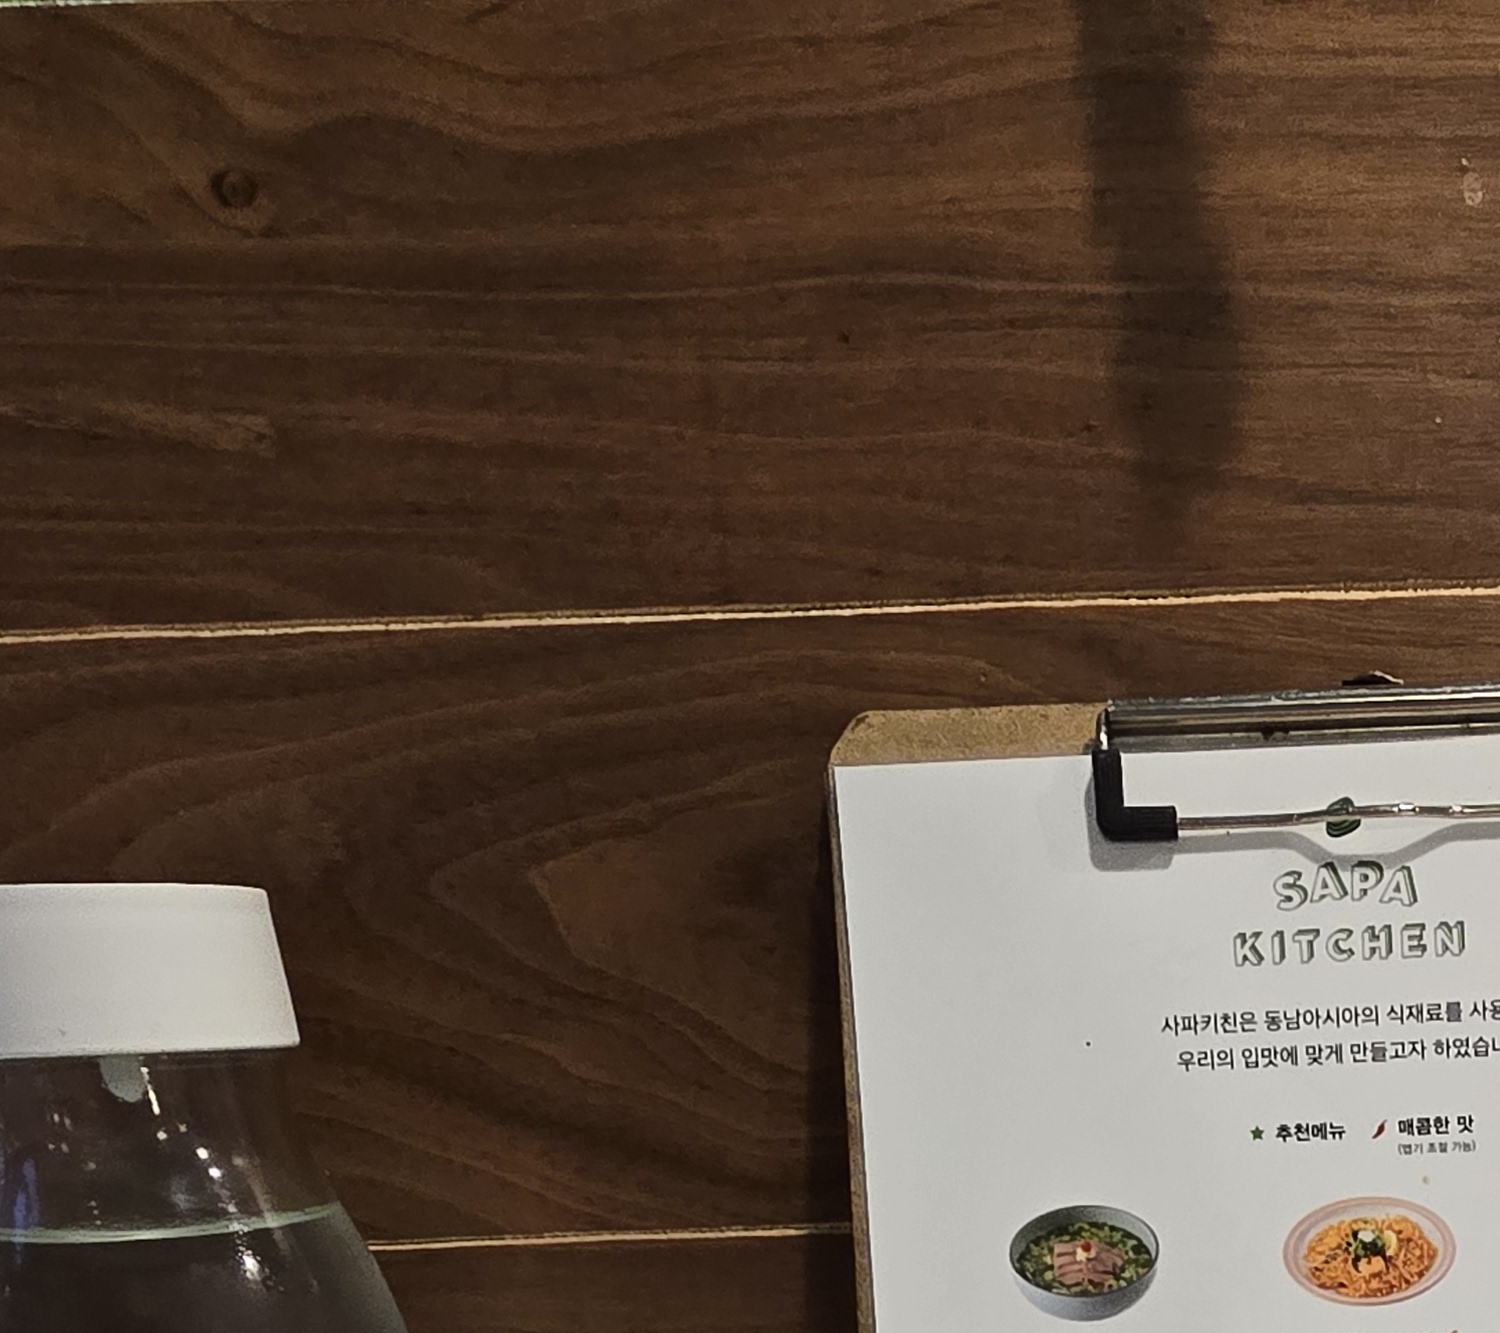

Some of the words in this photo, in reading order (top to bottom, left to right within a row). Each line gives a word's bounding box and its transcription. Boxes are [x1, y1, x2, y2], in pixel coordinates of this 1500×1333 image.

[1273, 860, 1418, 911] SAPA
[1233, 920, 1467, 967] KITCHEN
[1160, 1011, 1257, 1036] 사파키친은
[1263, 1004, 1379, 1031] 동남아시아의
[1386, 1001, 1462, 1025] 식재료를
[1177, 1047, 1234, 1072] 우리의
[1241, 1044, 1298, 1069] 입맛에
[1305, 1042, 1343, 1066] 맞게
[1349, 1038, 1426, 1063] 만들고자
[1275, 1121, 1346, 1143] 추천메뉴
[1397, 1115, 1449, 1136] 매콤한
[1456, 1114, 1474, 1133] 맛
